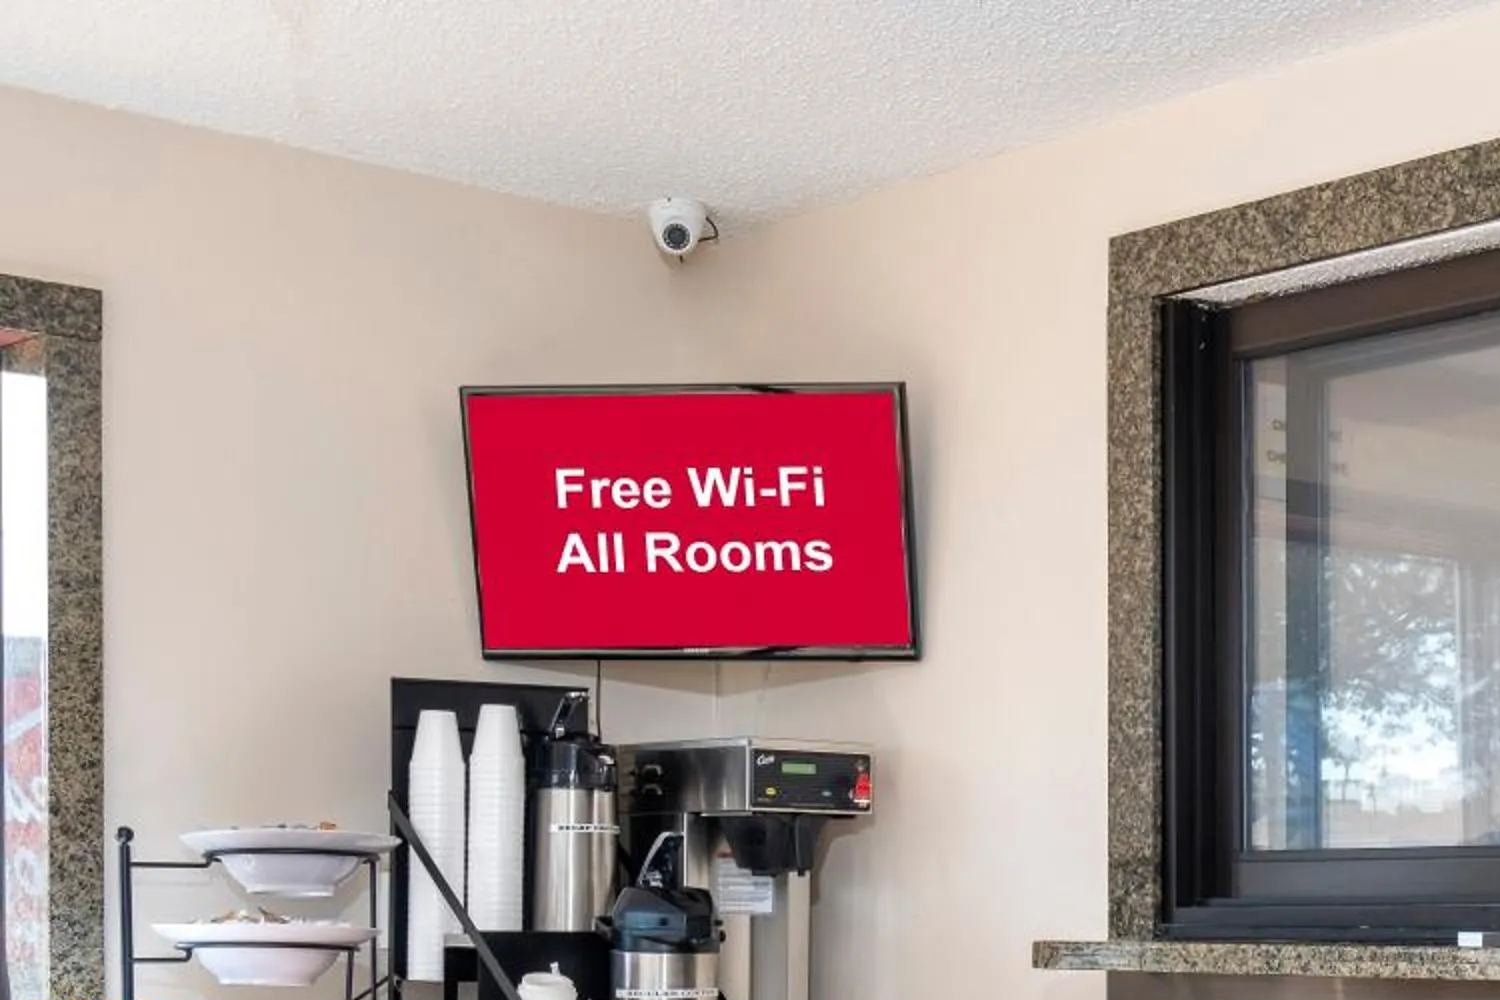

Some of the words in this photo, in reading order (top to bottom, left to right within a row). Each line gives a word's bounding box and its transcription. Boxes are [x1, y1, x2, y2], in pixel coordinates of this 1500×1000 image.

[556, 469, 671, 508] Free
[688, 467, 824, 506] Wi-Fi
[557, 533, 624, 572] All
[646, 532, 832, 572] Rooms
